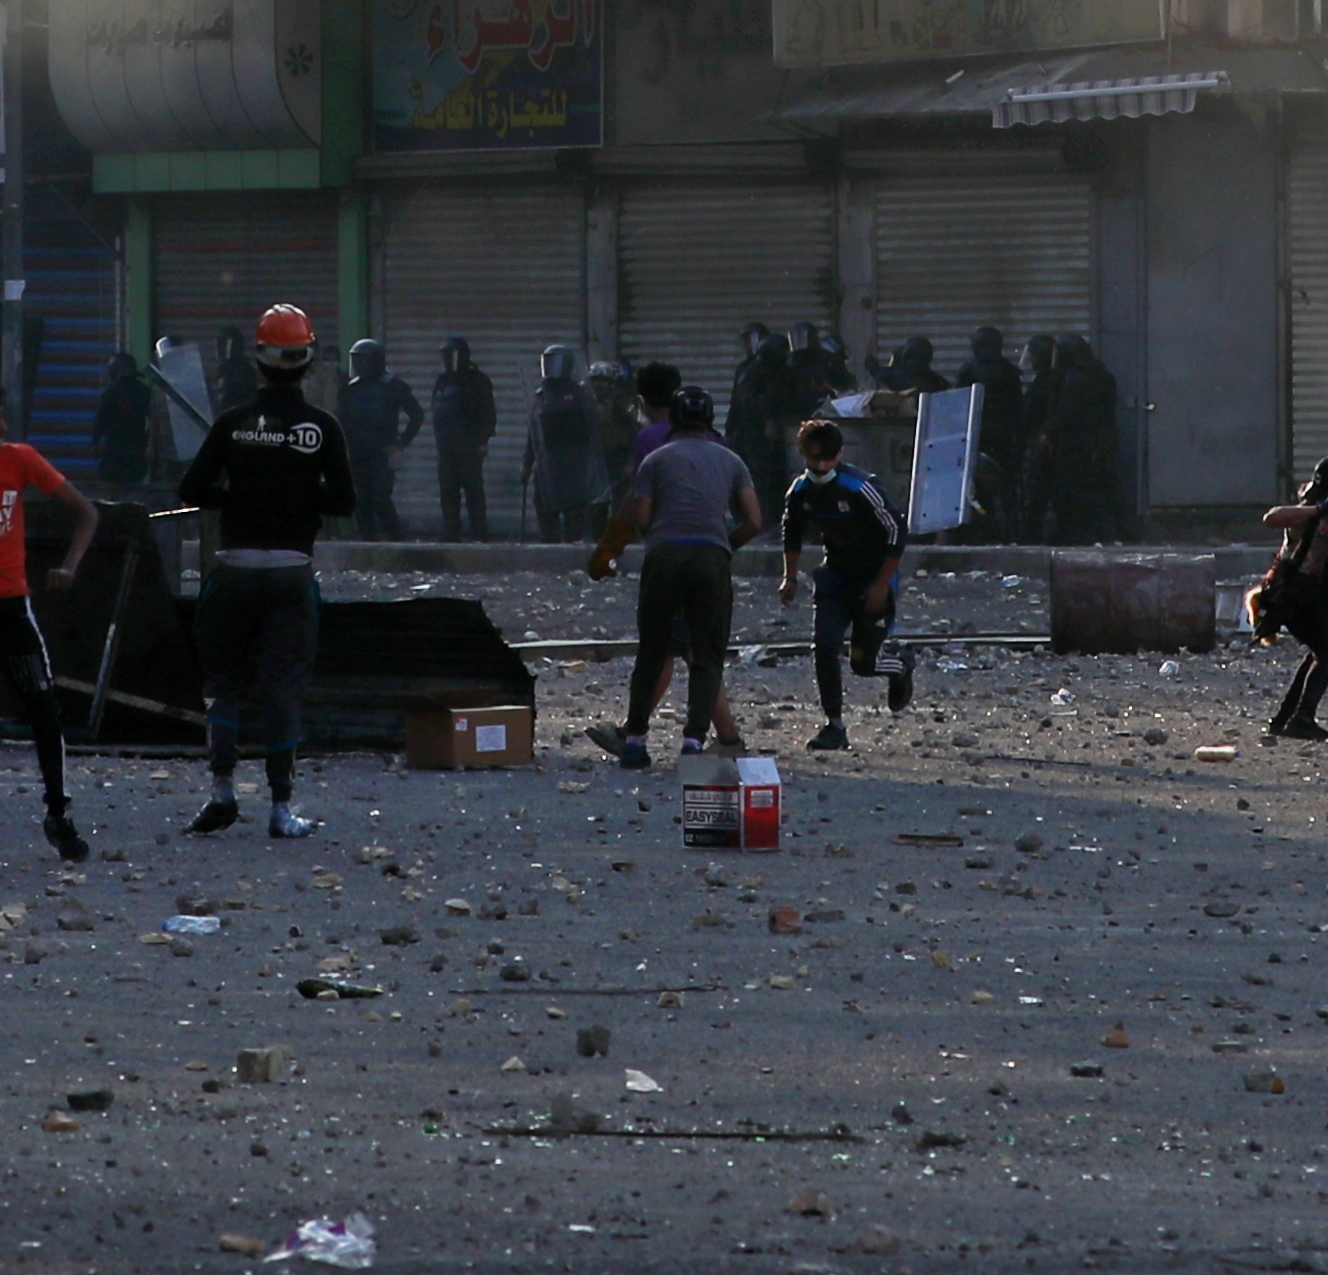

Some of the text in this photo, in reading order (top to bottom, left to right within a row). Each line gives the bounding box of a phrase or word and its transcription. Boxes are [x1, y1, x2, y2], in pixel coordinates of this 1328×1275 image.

[411, 84, 568, 139] للتجارة العامة
[686, 810, 738, 824] EASYSEAL
